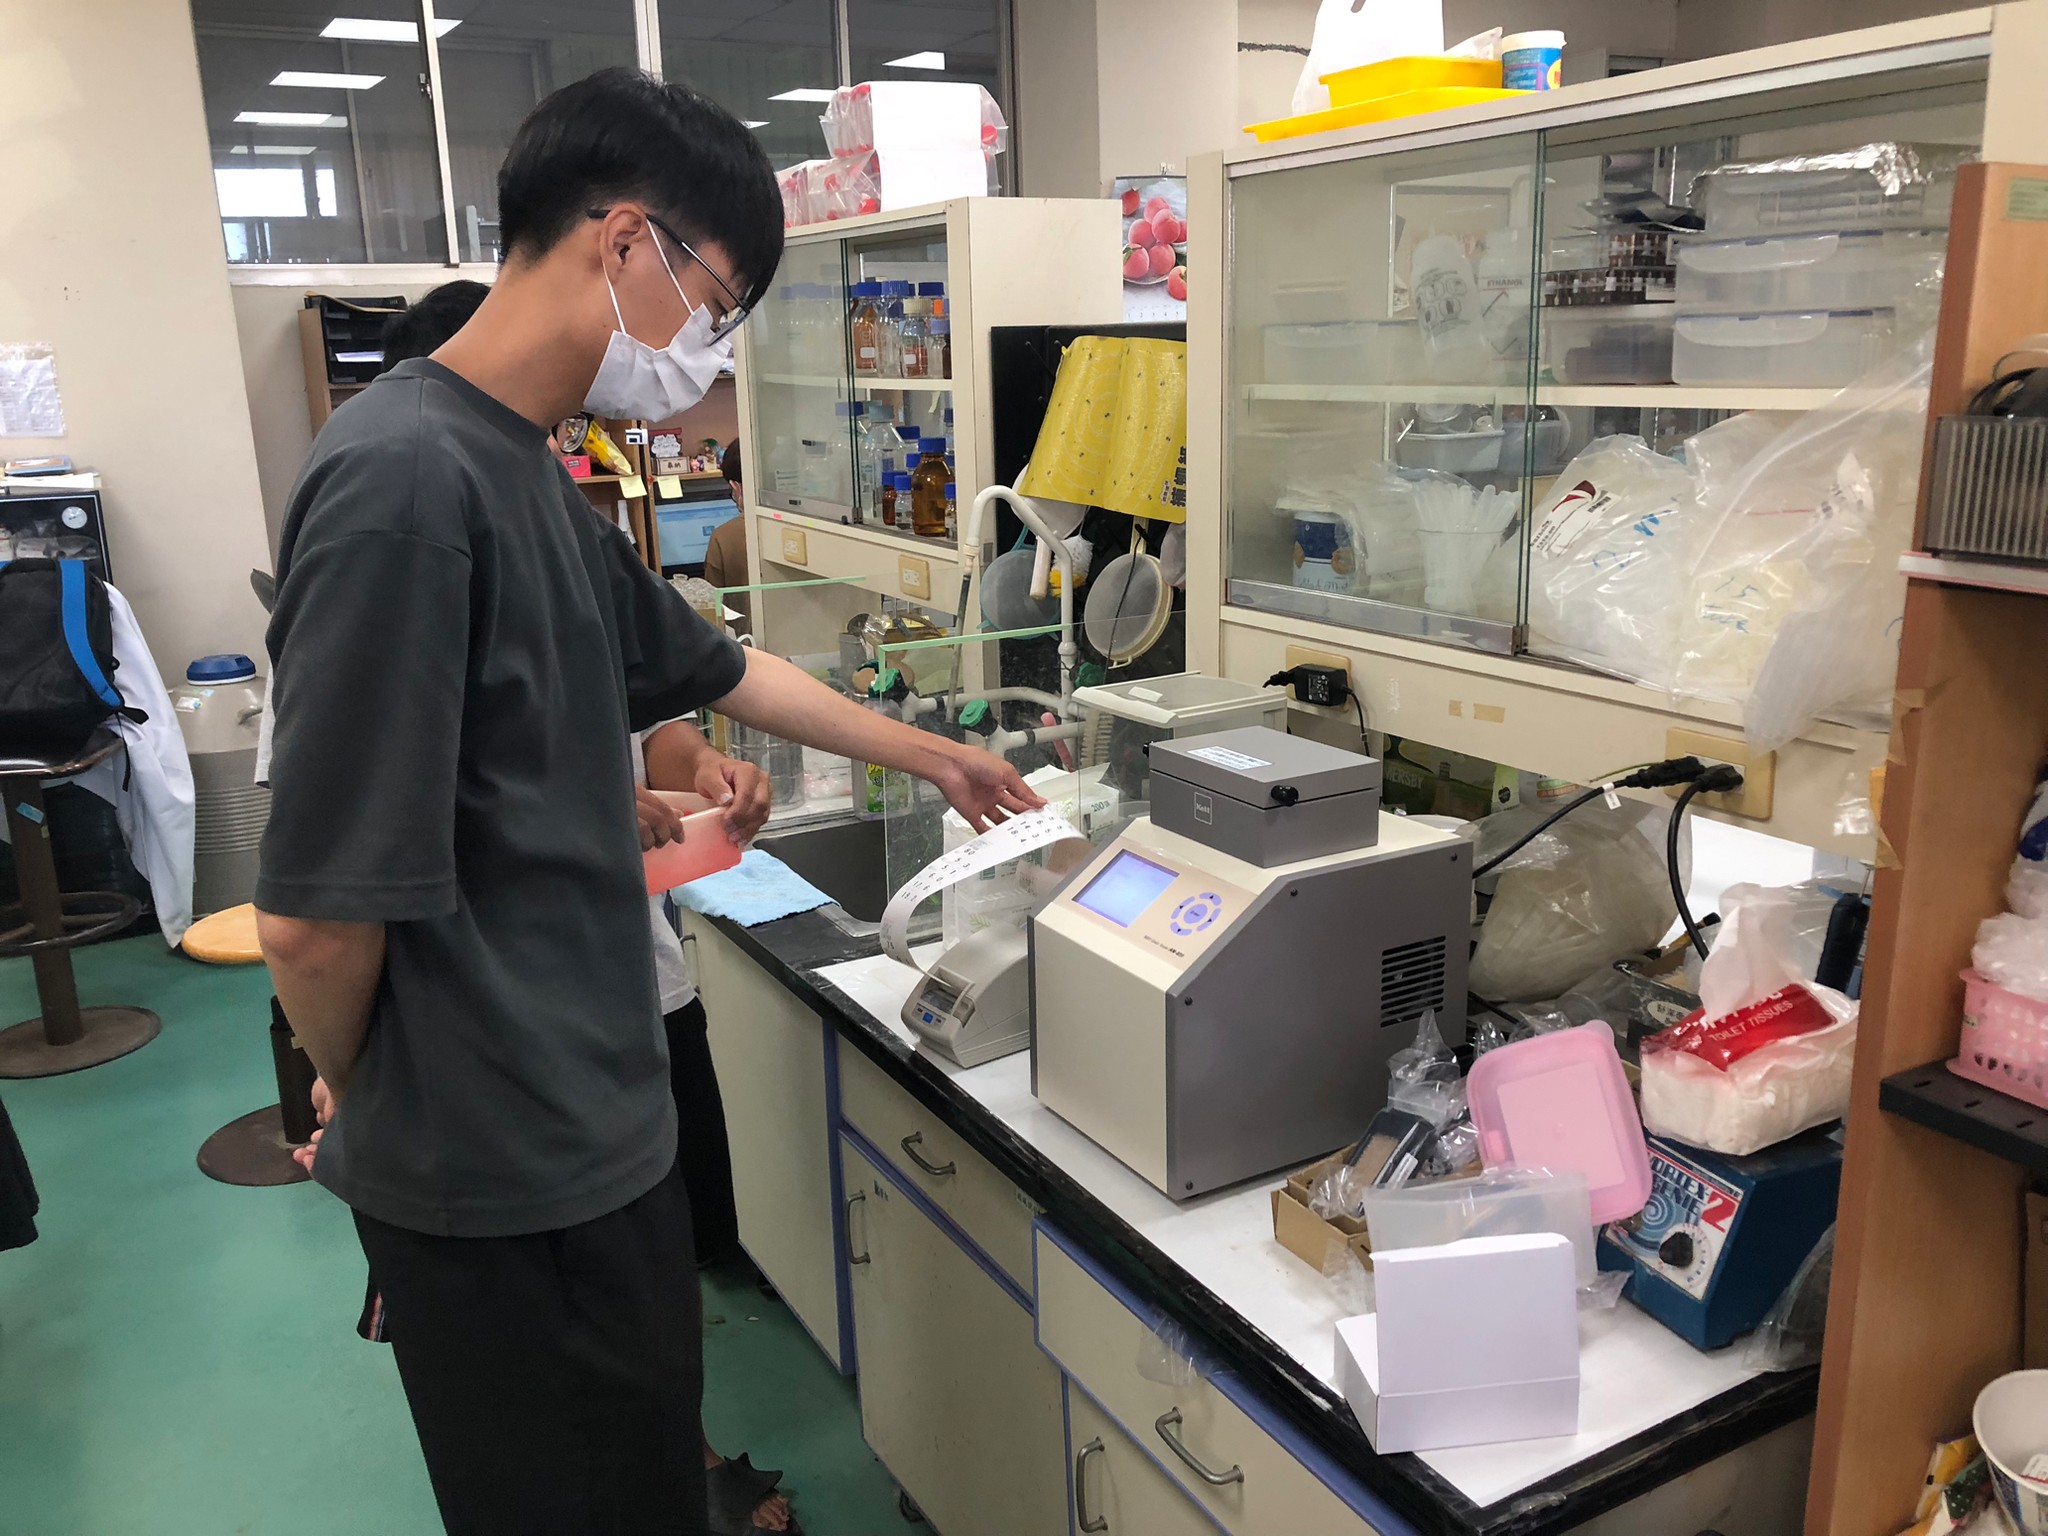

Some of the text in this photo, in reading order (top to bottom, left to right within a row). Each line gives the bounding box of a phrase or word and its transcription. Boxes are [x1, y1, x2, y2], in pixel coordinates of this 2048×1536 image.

[1708, 1021, 1747, 1041] TOILET
[1748, 1000, 1793, 1028] TISSUES
[1701, 1191, 1738, 1233] 2
